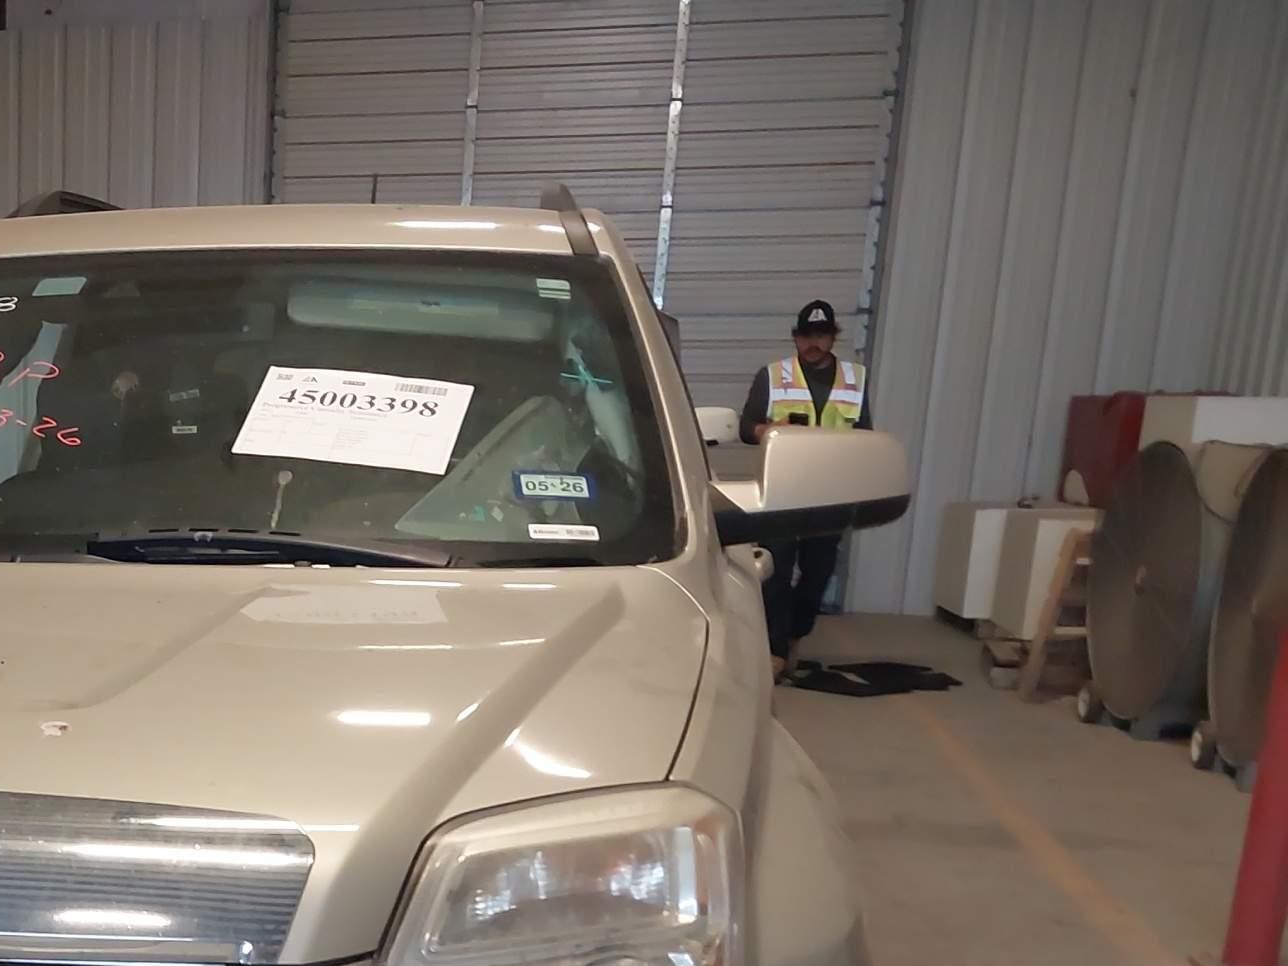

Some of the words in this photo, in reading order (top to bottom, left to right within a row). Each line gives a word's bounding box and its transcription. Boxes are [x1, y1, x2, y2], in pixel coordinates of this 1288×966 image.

[279, 388, 439, 418] 45003398
[525, 480, 549, 491] 05
[560, 481, 584, 493] 26
